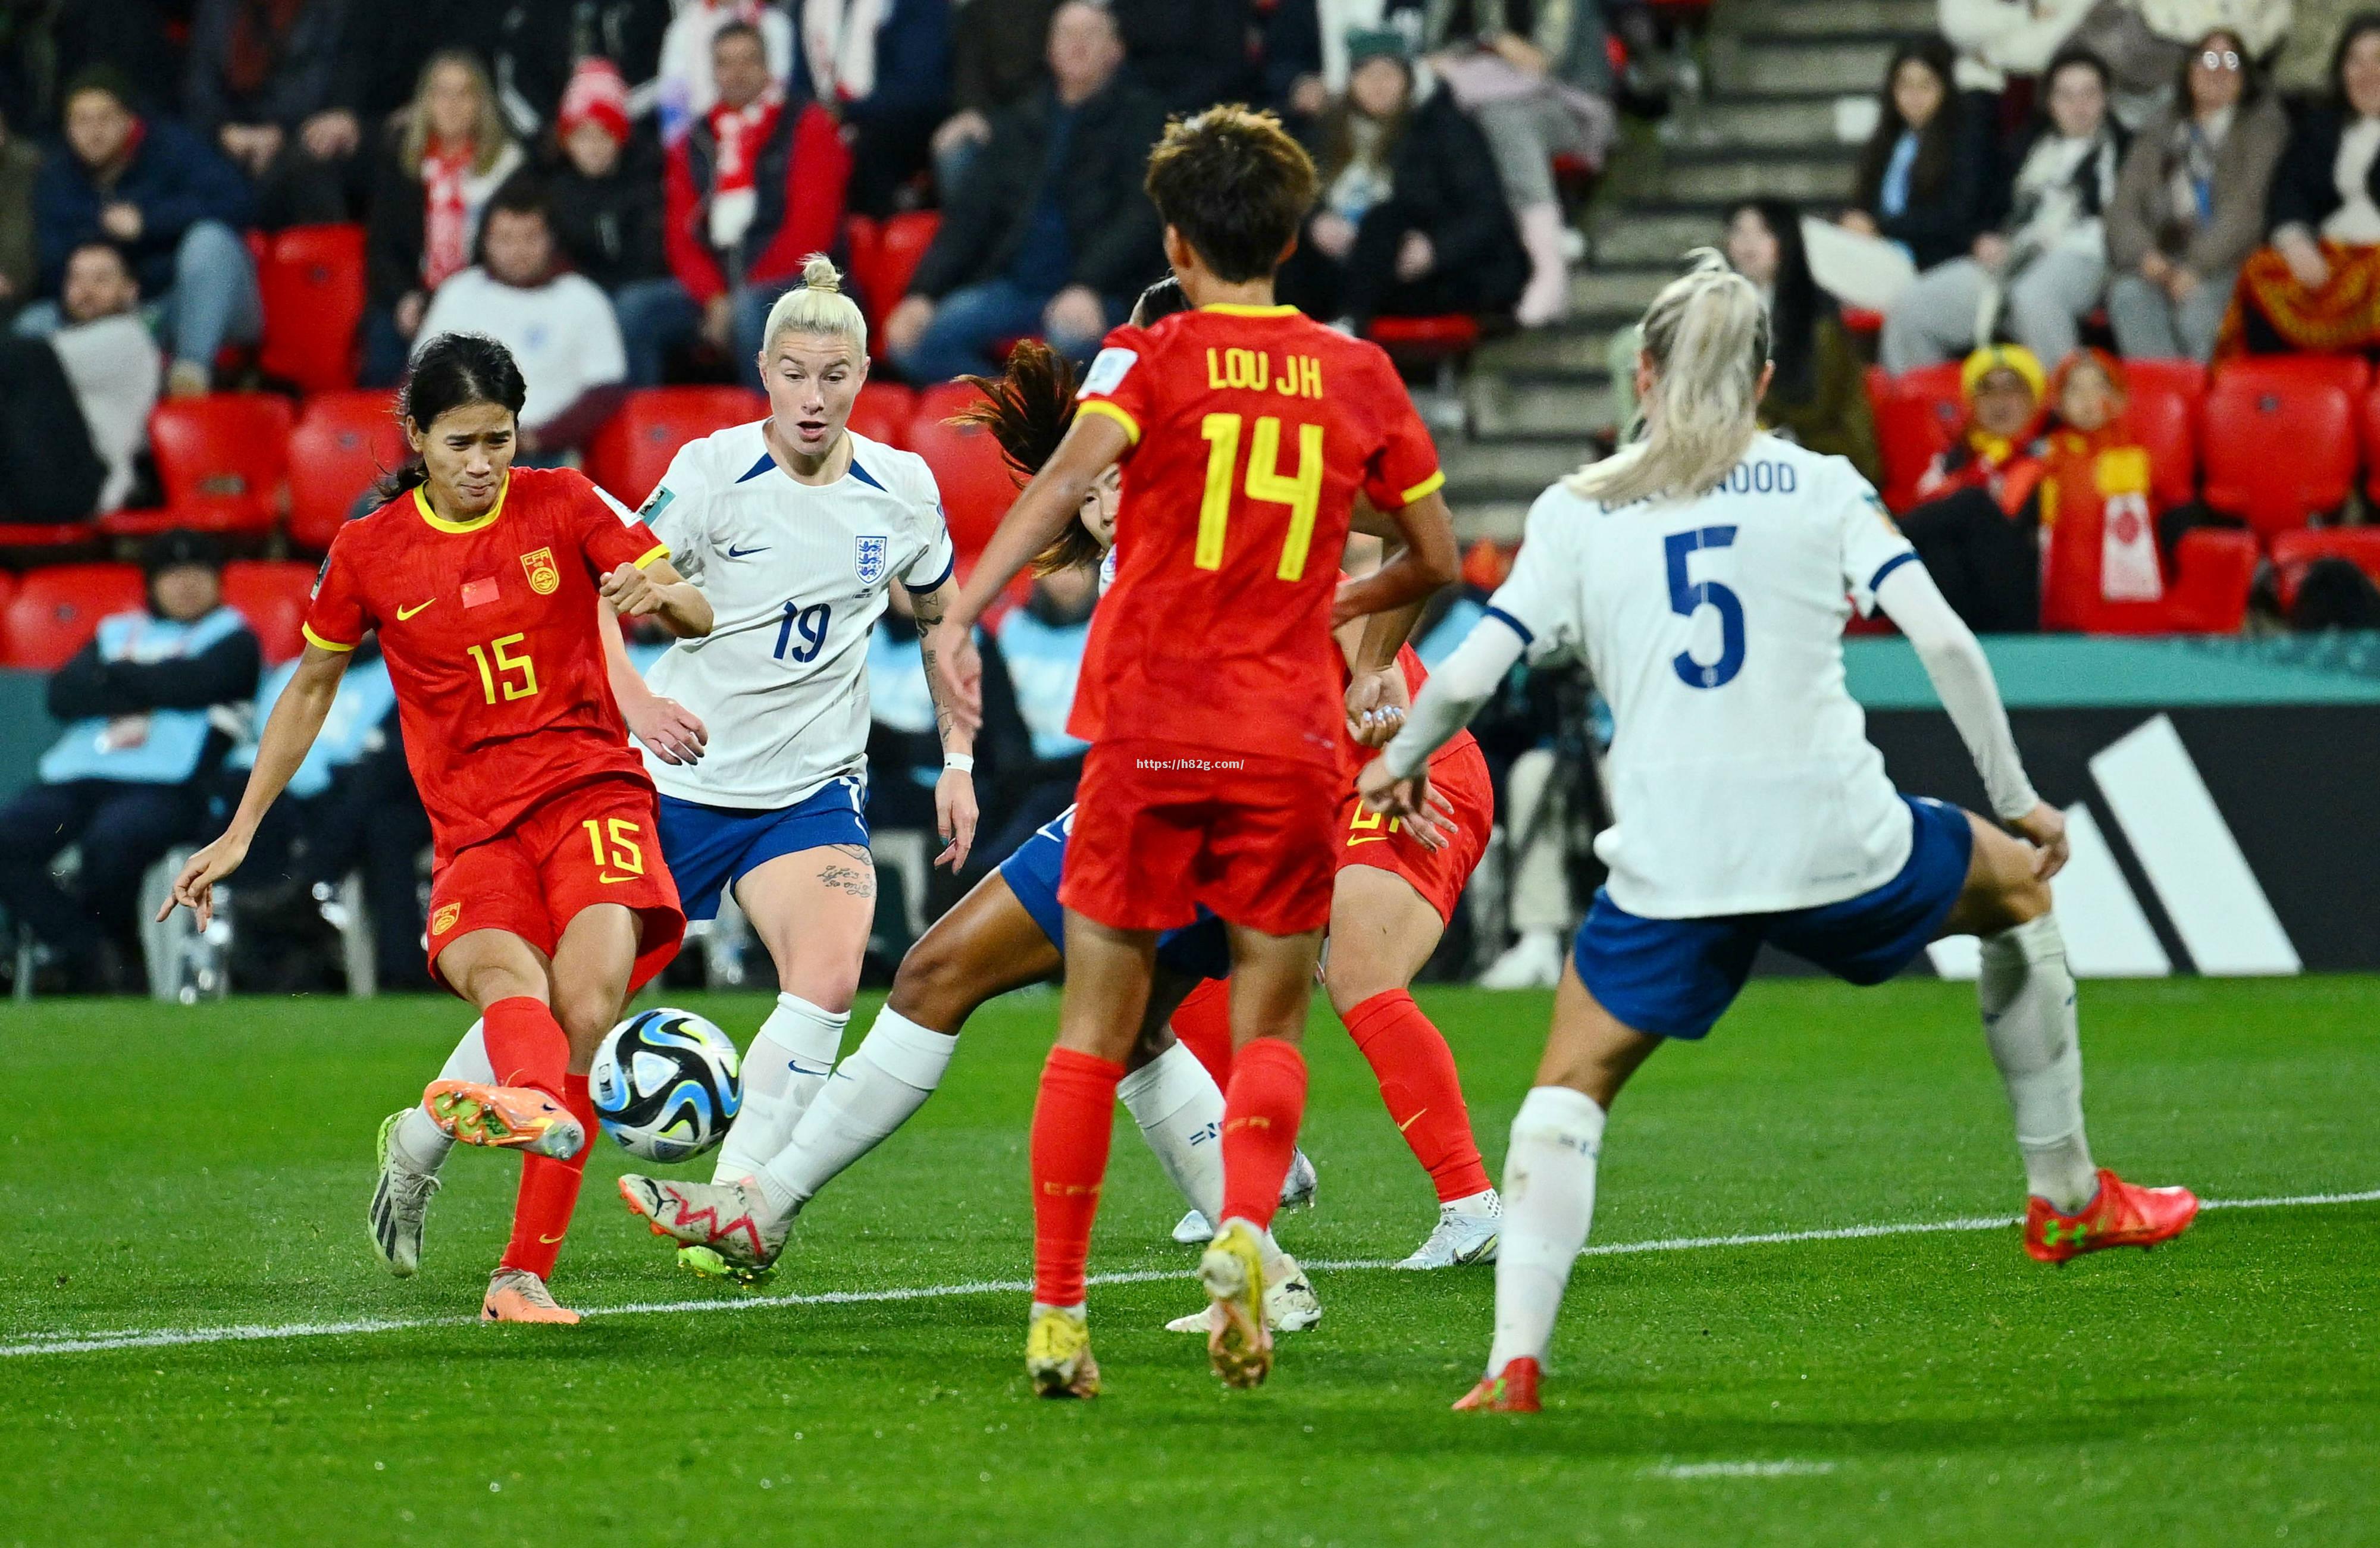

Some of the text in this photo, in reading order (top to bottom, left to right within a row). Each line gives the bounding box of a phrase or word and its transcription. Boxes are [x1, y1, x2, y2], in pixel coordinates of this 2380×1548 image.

[1207, 347, 1323, 399] LOU JH
[1194, 412, 1324, 582] 14
[524, 550, 549, 565] CFA
[773, 601, 831, 663] 19
[1664, 525, 1746, 688] 5
[468, 632, 538, 704] 15
[583, 817, 644, 875] 15
